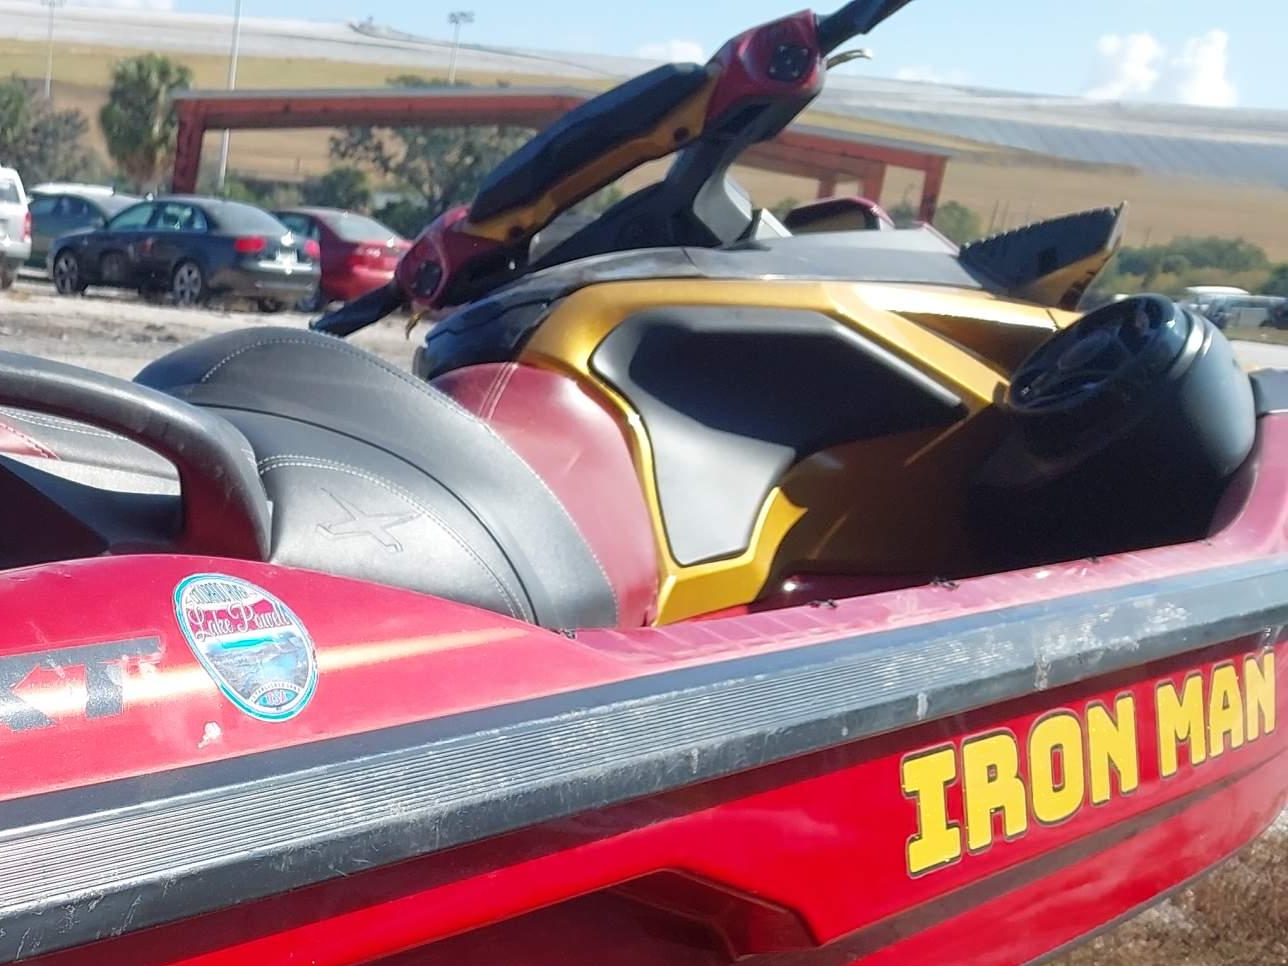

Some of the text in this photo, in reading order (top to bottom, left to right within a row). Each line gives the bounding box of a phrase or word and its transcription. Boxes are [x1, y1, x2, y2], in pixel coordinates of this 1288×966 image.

[187, 601, 293, 641] Lake Powell
[901, 649, 1277, 879] IRON MAN
